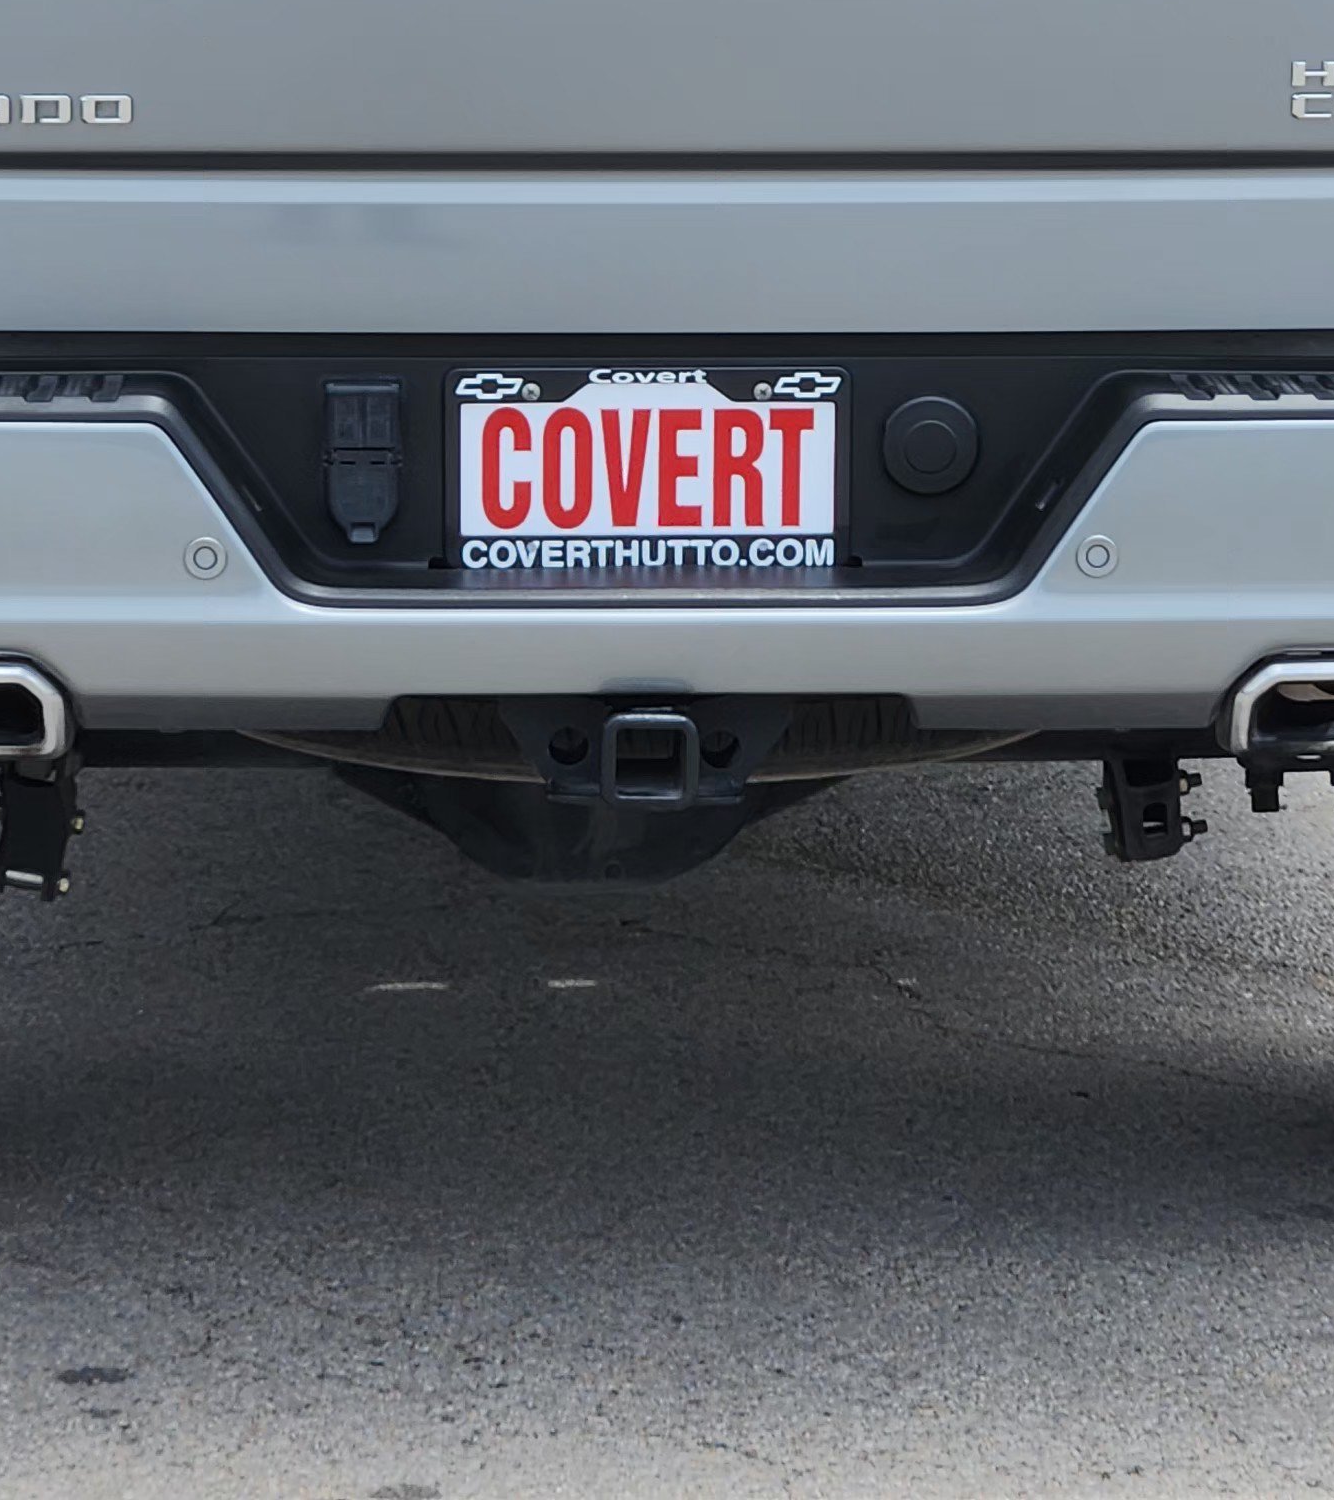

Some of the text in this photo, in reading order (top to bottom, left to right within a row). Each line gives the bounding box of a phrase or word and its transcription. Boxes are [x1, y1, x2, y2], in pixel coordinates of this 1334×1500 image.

[588, 368, 707, 385] Covert
[481, 406, 815, 530] COVERT
[462, 538, 835, 569] COVERTHUTTO.COM
